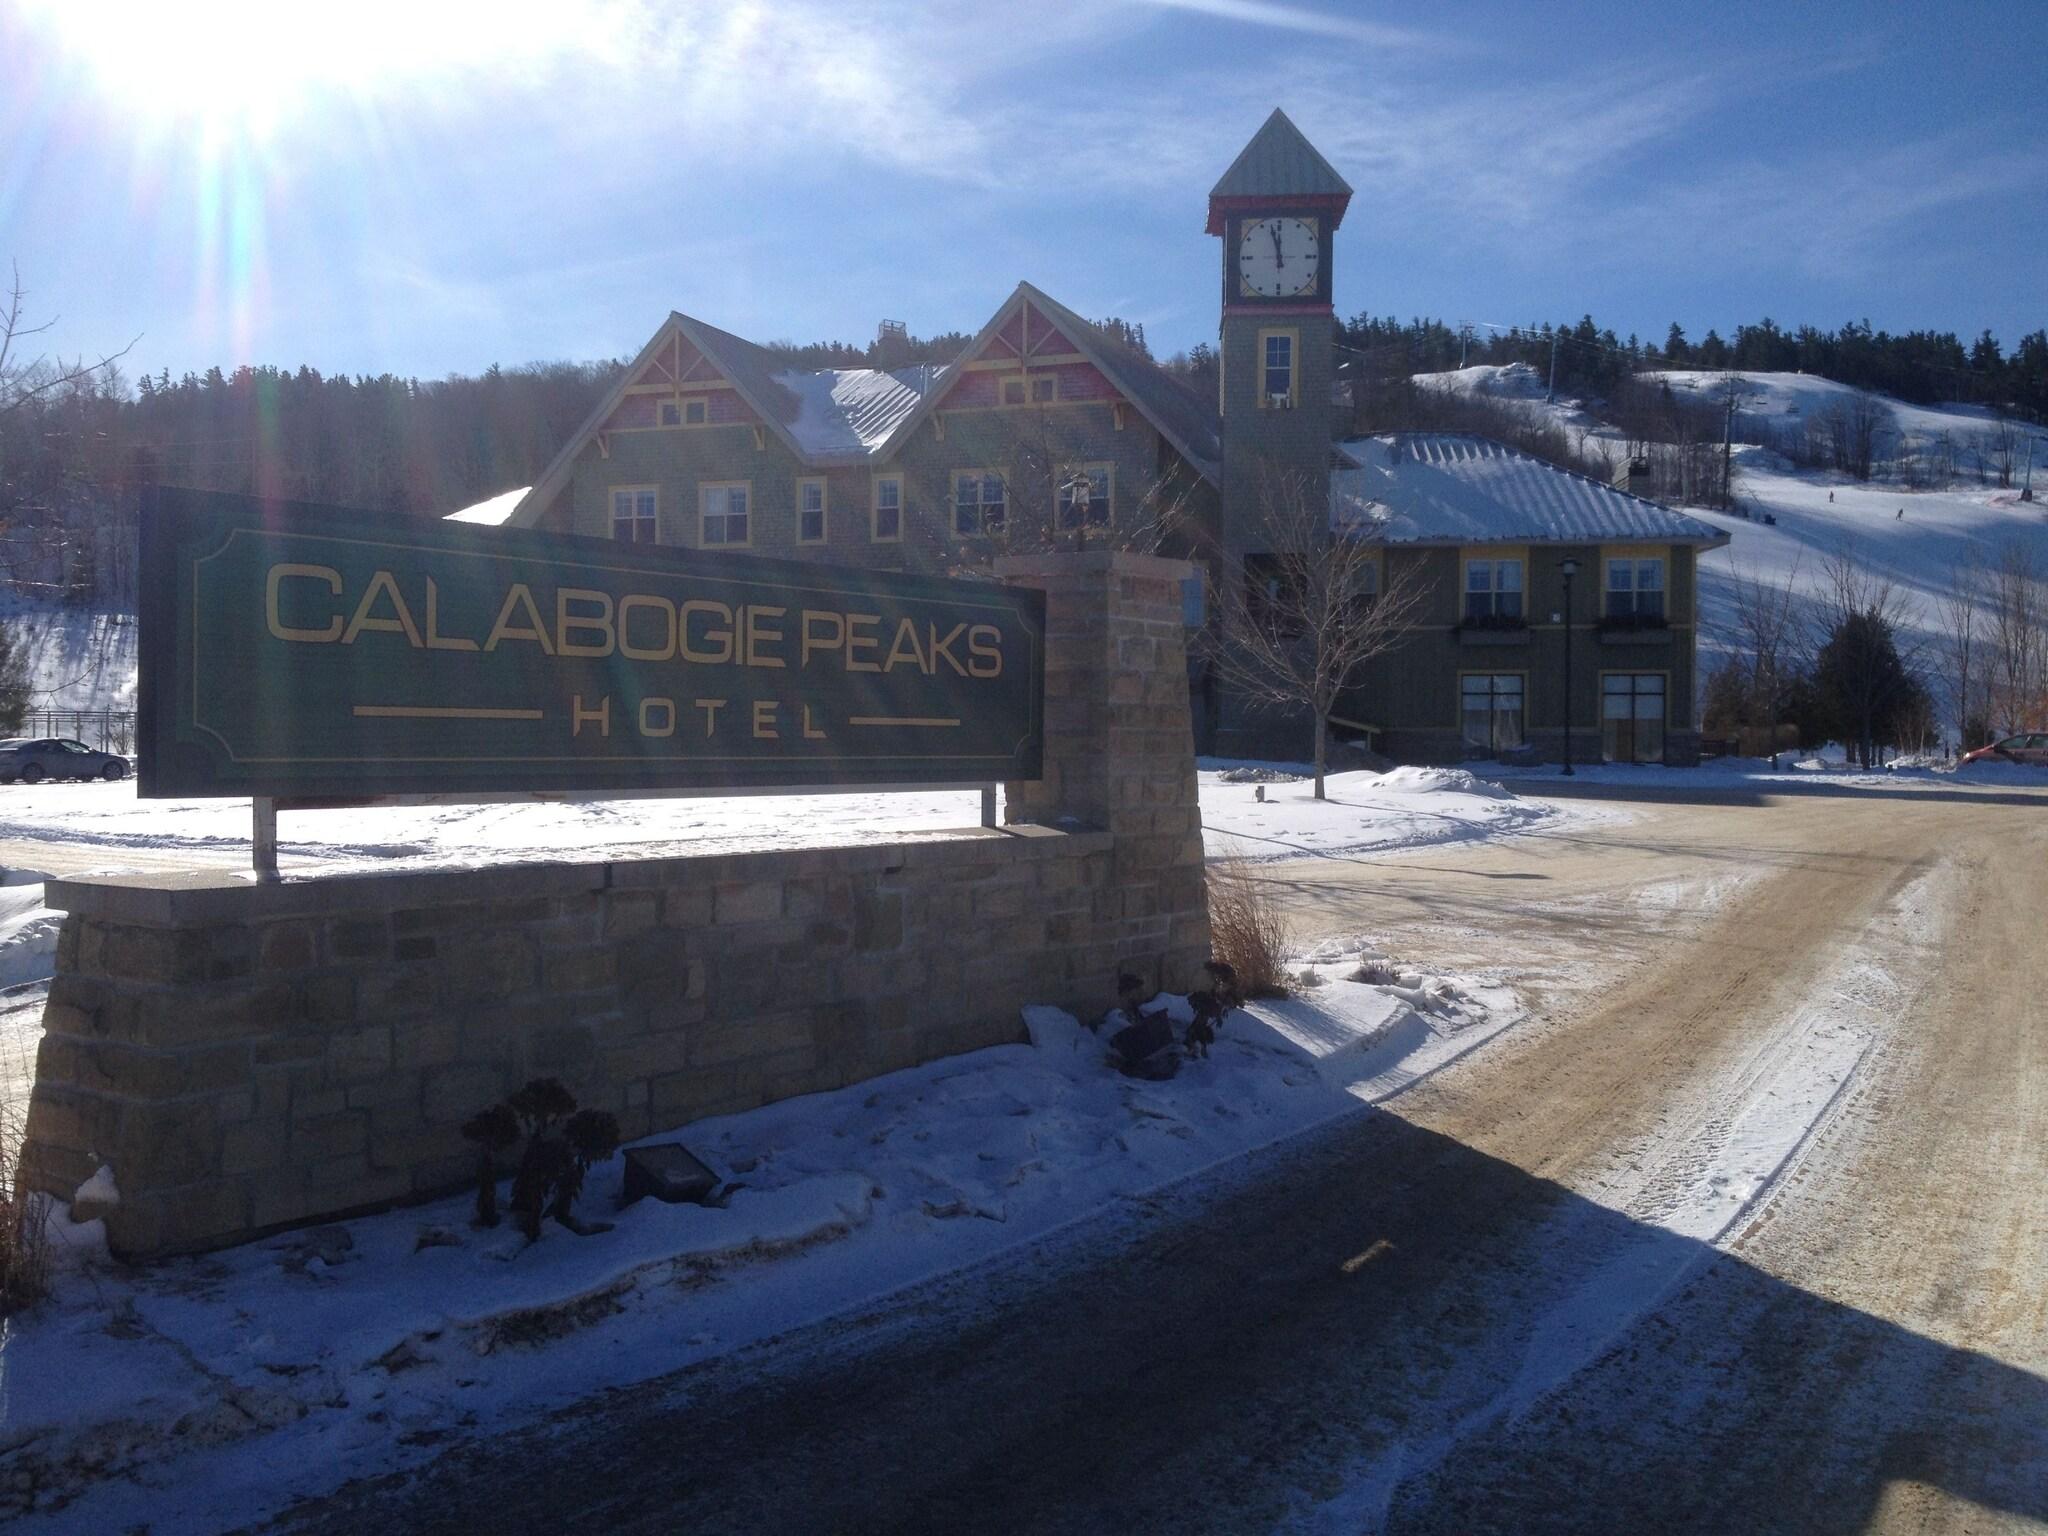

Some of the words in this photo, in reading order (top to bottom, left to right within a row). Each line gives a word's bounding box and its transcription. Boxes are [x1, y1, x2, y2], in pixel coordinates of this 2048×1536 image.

[266, 563, 787, 668] CALABOGIE
[801, 609, 1002, 679] PEAKS
[573, 695, 827, 739] HOTEL
